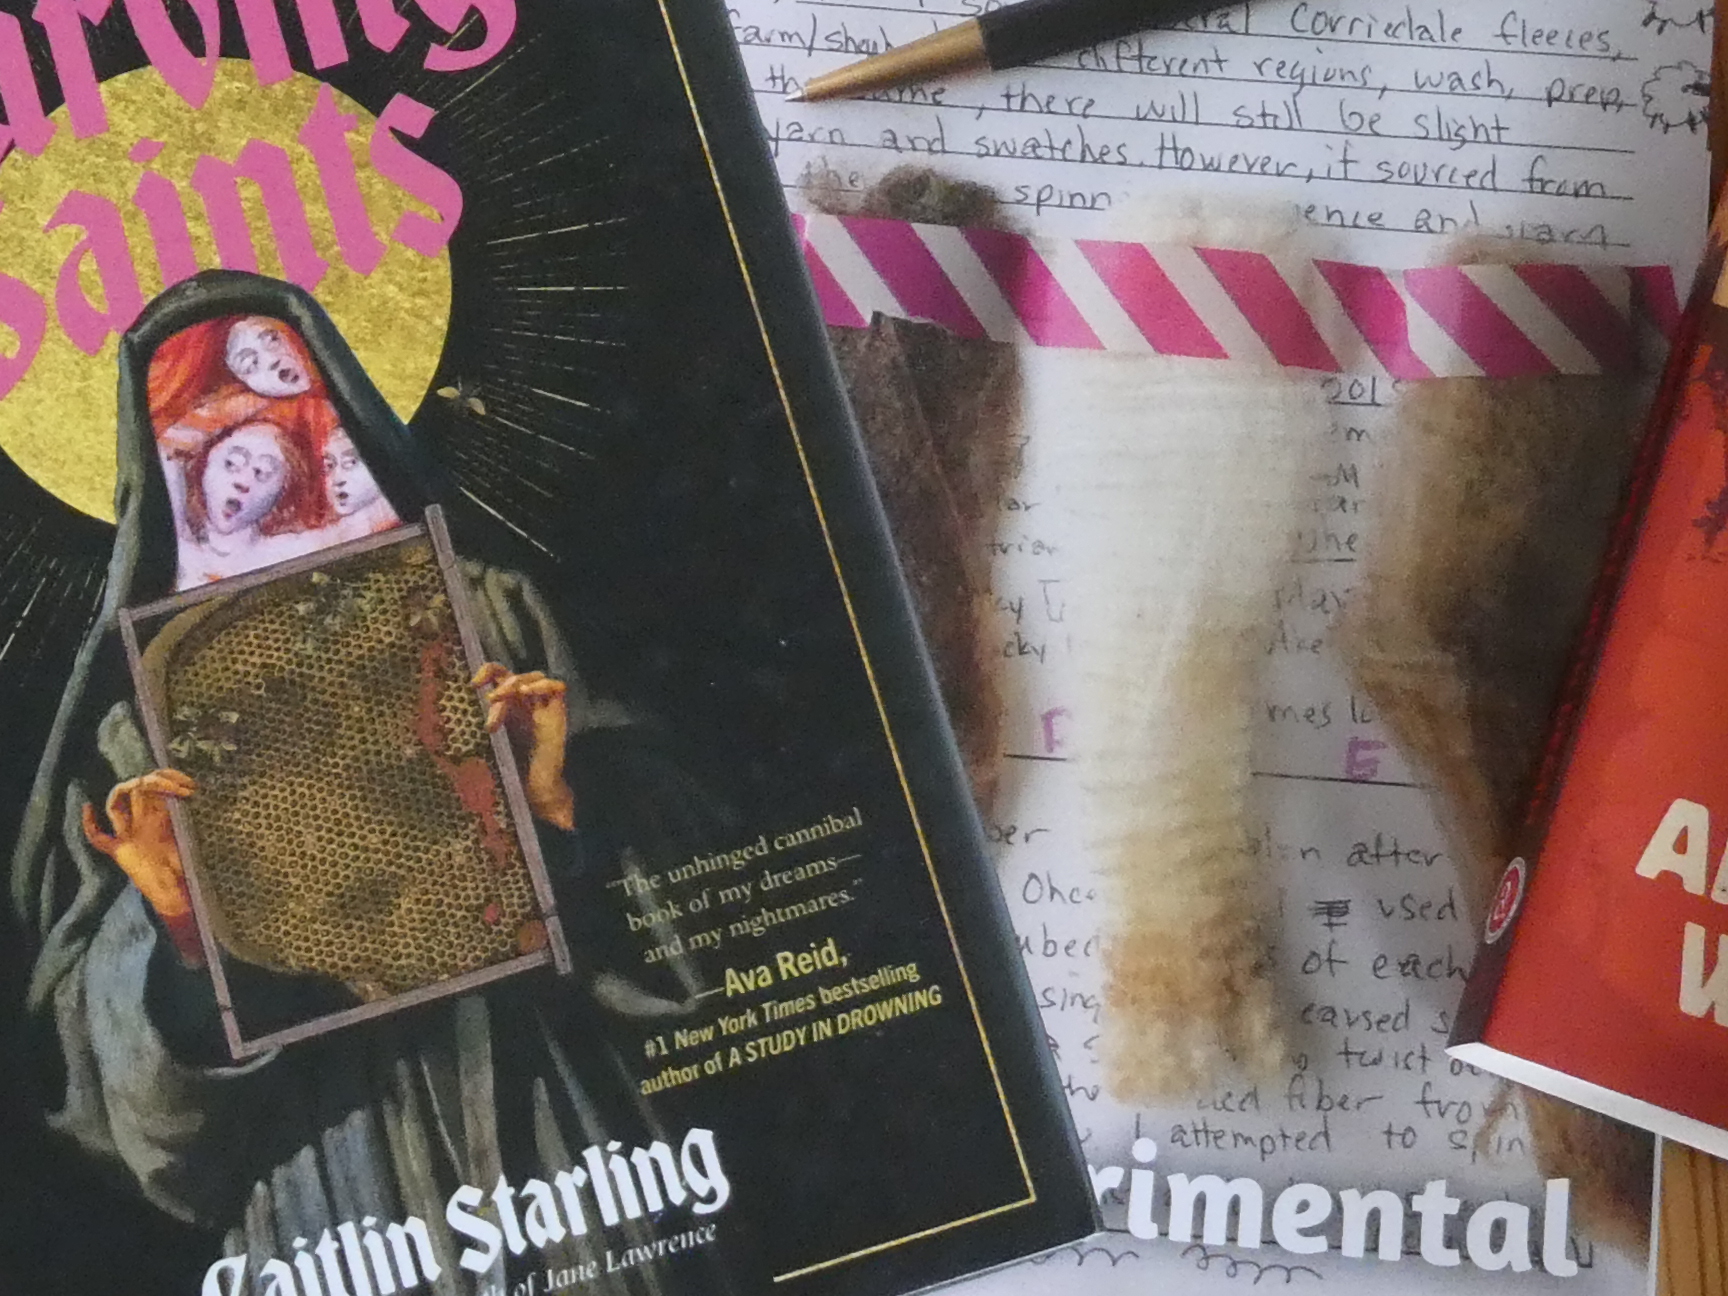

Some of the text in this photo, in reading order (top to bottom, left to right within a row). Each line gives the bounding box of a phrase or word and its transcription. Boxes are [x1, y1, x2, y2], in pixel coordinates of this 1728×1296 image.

[1289, 3, 1464, 45] Corriedale
[1254, 47, 1389, 99] regions,
[1000, 85, 1511, 150] there will still be slight
[881, 117, 947, 155] and
[1155, 132, 1314, 183] However,
[1376, 154, 1497, 191] sourced
[1522, 154, 1606, 198] from
[667, 836, 770, 883] unhinged
[773, 806, 864, 851] cannibal
[1347, 833, 1443, 867] after
[625, 907, 684, 933] book
[688, 890, 712, 914] of
[718, 882, 753, 906] my
[643, 939, 684, 964] and
[688, 926, 724, 951] my
[776, 937, 850, 981] Reid,
[639, 984, 943, 1096] author of A STUDY IN DROWNING
[644, 962, 921, 1059] #1 New York Times bestselling
[1170, 1114, 1332, 1162] attempted
[1383, 1122, 1417, 1150] to
[446, 1127, 731, 1275] Starling
[1088, 1137, 1579, 1277] rimental
[543, 1259, 599, 1293] Jane
[606, 1222, 718, 1272] Lawrence
